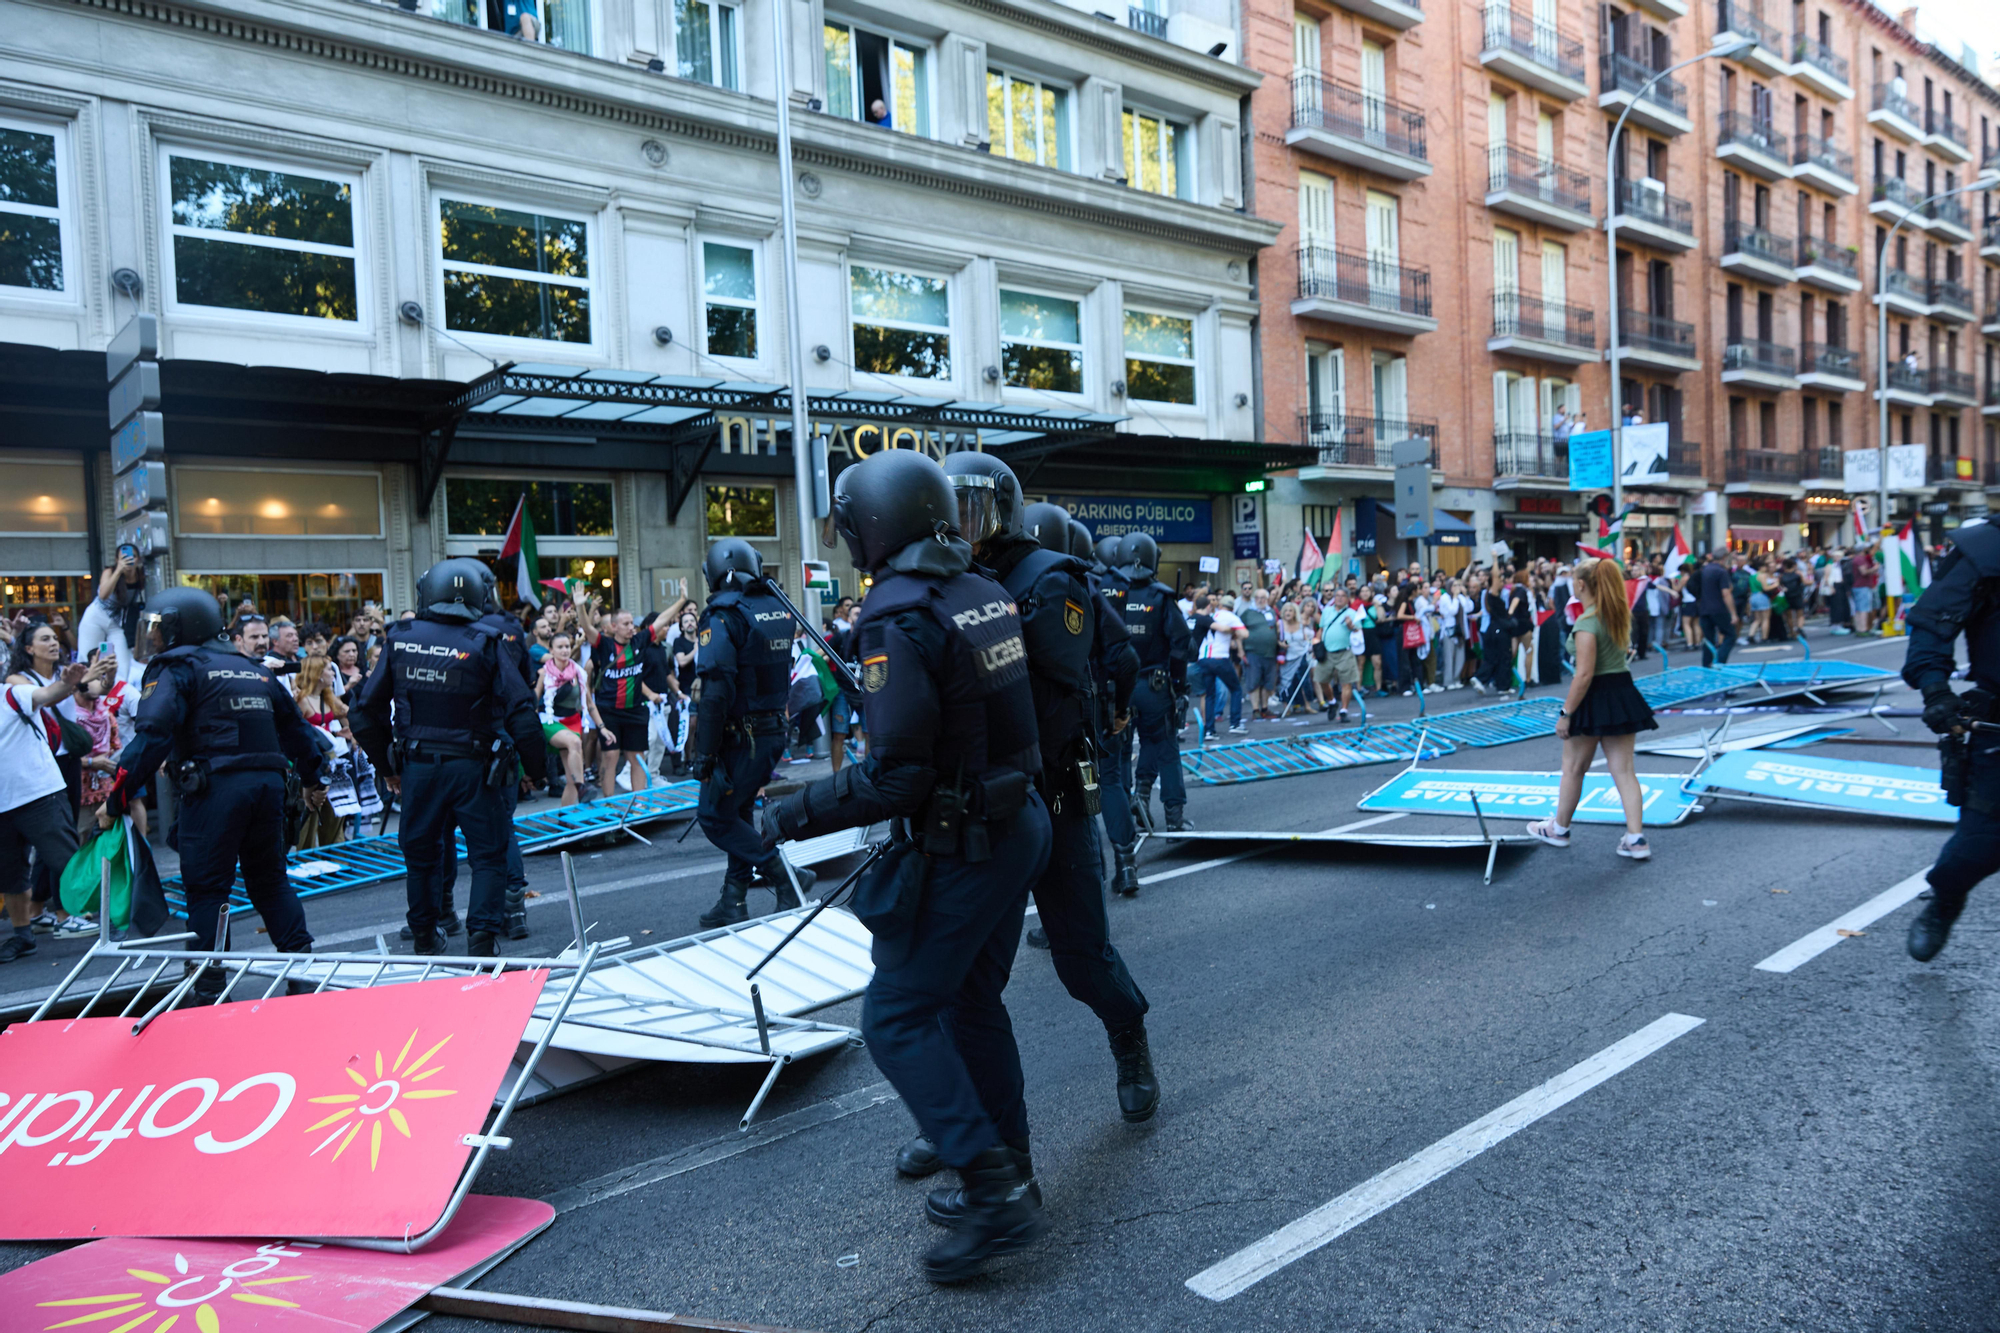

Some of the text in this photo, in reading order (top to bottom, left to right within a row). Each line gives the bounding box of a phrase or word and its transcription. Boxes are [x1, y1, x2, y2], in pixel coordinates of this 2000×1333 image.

[813, 420, 983, 462] ACIONA
[1068, 501, 1195, 521] PARKING PÚBLICO
[1237, 497, 1255, 522] P
[1095, 524, 1164, 537] ABIERTO 24 H
[754, 610, 788, 622] POLICIA
[951, 600, 1011, 631] POLICIA
[394, 641, 459, 657] POLICIA
[207, 669, 262, 680] POLICIA
[406, 666, 447, 683] UC24
[1744, 769, 1947, 805] OTERÍAS
[0, 1071, 297, 1167] Cofidi
